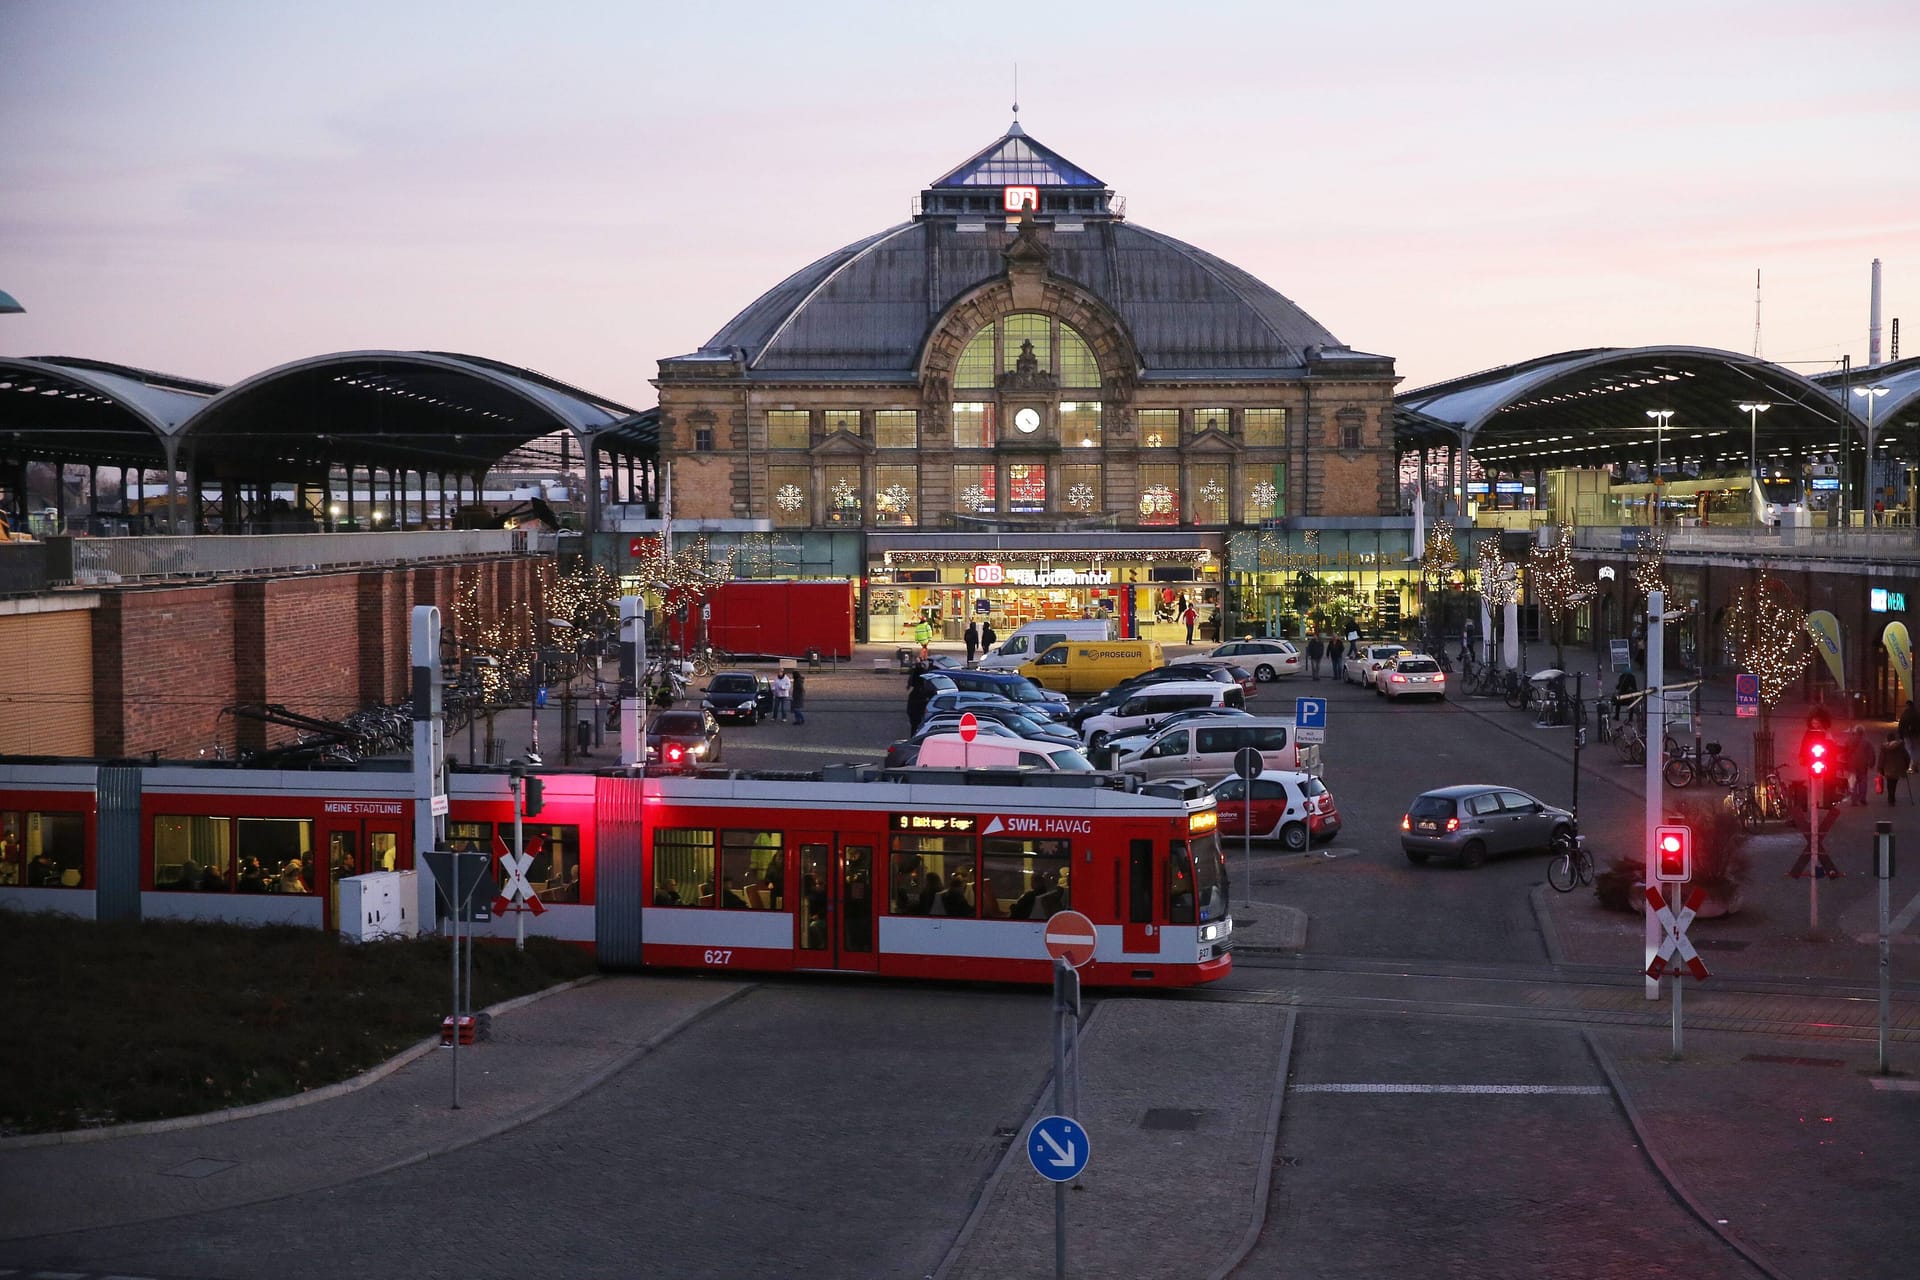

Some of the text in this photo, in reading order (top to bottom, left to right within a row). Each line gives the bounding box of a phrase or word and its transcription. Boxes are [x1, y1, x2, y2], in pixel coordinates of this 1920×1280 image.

[1009, 191, 1034, 206] DB
[978, 567, 1000, 581] DB
[1014, 570, 1112, 587] Hauptbahnhof
[1303, 702, 1318, 724] P
[325, 803, 402, 814] MEINE STADTLINIE
[1008, 818, 1091, 834] SWH. HAVAG
[704, 950, 732, 964] 627
